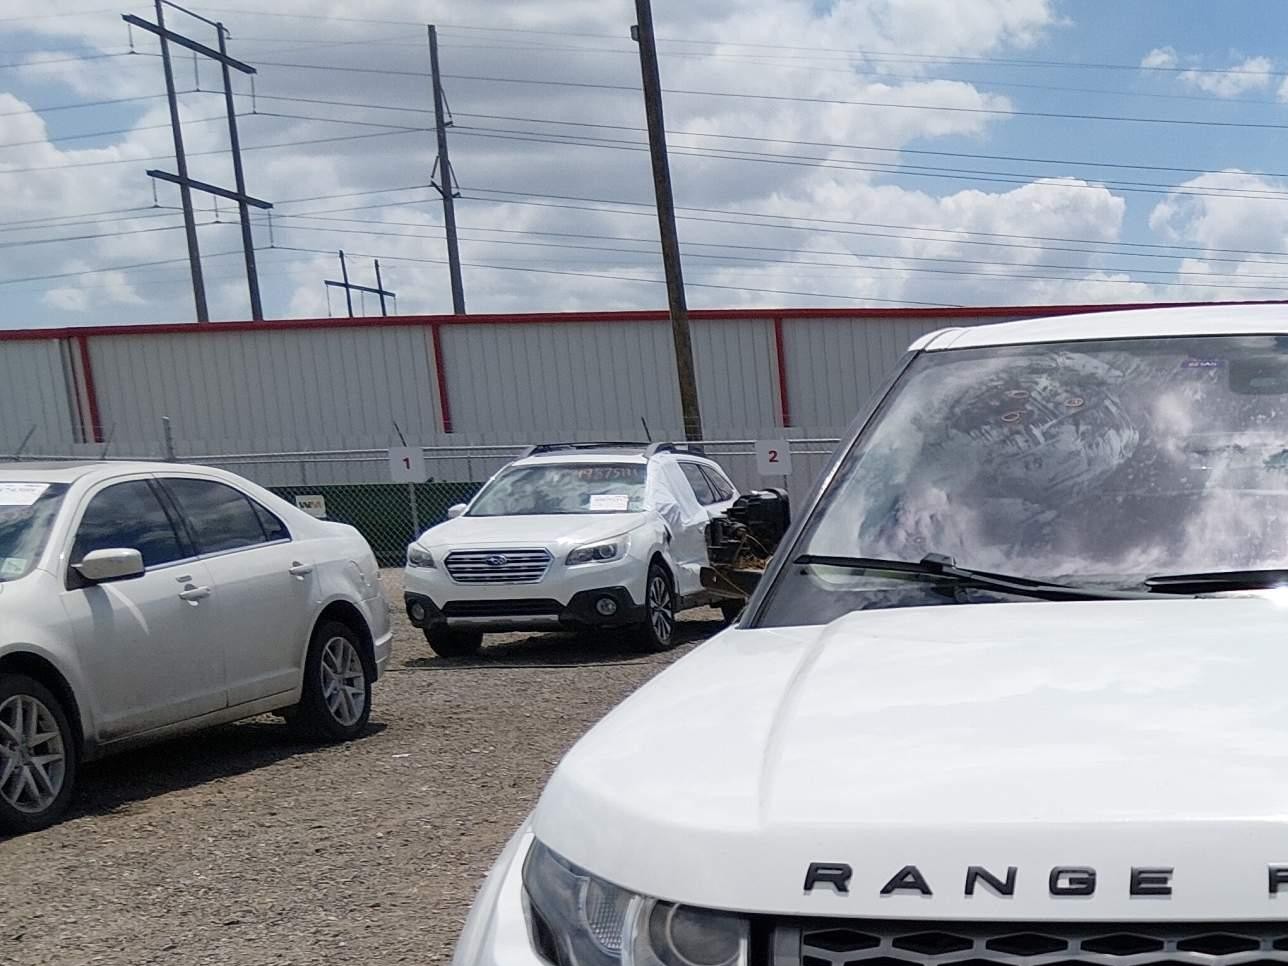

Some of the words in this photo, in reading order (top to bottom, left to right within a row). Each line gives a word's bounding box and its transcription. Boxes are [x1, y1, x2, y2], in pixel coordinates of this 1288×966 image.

[402, 457, 411, 469] 1
[768, 450, 779, 463] 2
[803, 862, 1175, 898] RANGE
